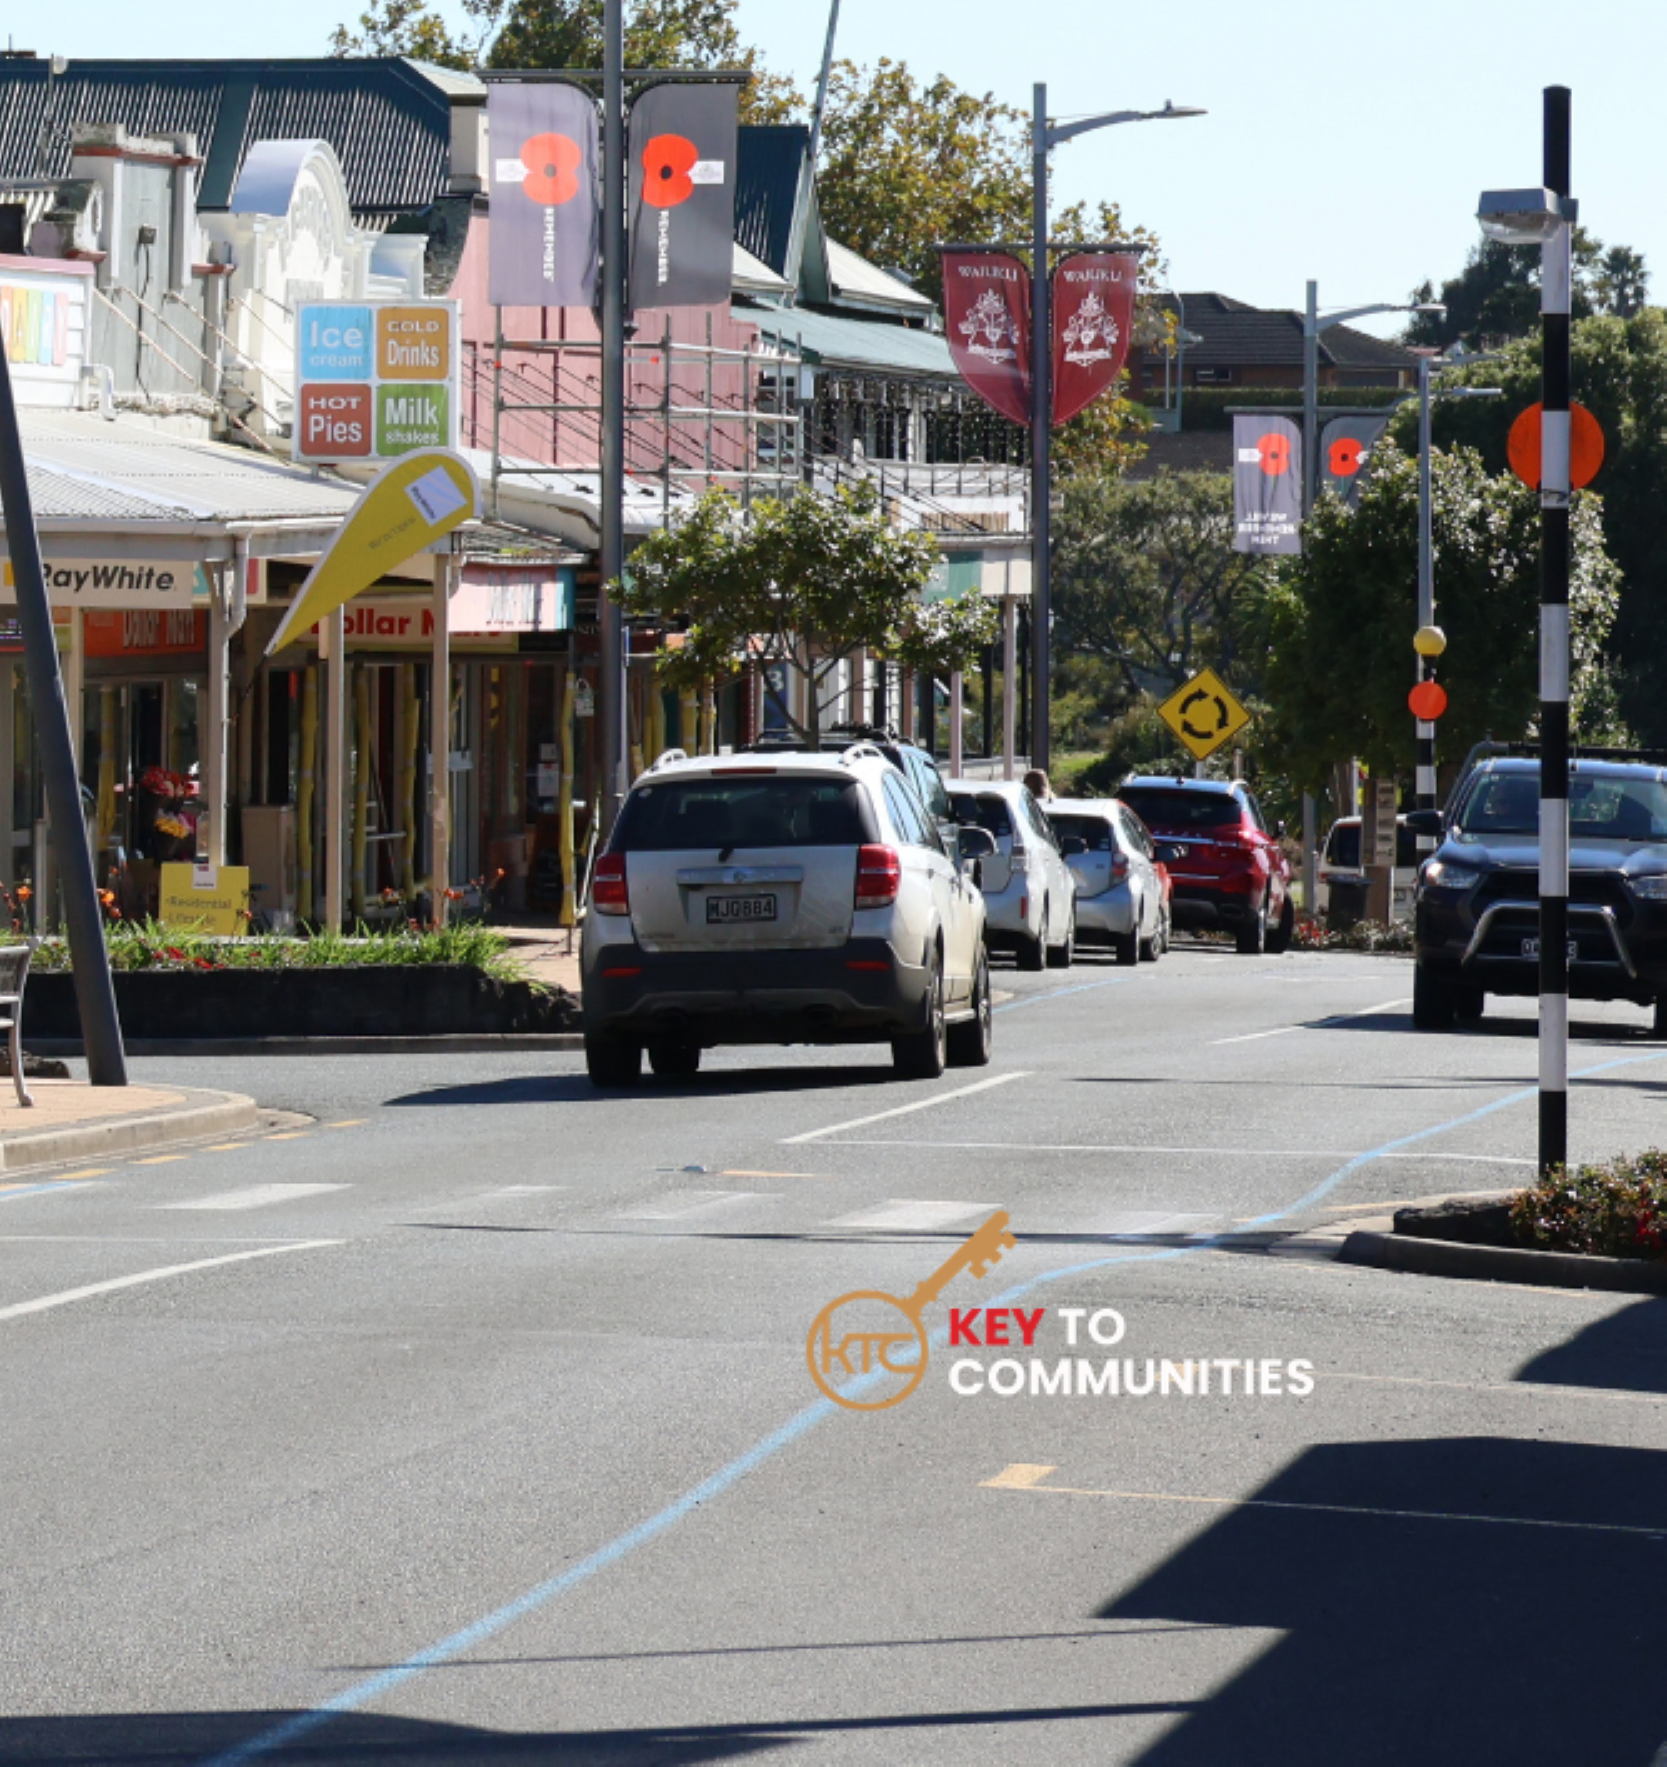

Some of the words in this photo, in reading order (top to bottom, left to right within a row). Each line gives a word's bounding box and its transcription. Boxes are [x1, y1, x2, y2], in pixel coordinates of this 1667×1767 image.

[309, 320, 364, 348] Ice
[386, 320, 440, 333] COLD
[309, 354, 363, 367] cream
[387, 338, 440, 367] Drinks
[308, 396, 362, 409] HOT
[385, 397, 439, 425] Milk
[309, 414, 362, 443] Pies
[385, 427, 440, 445] shakes
